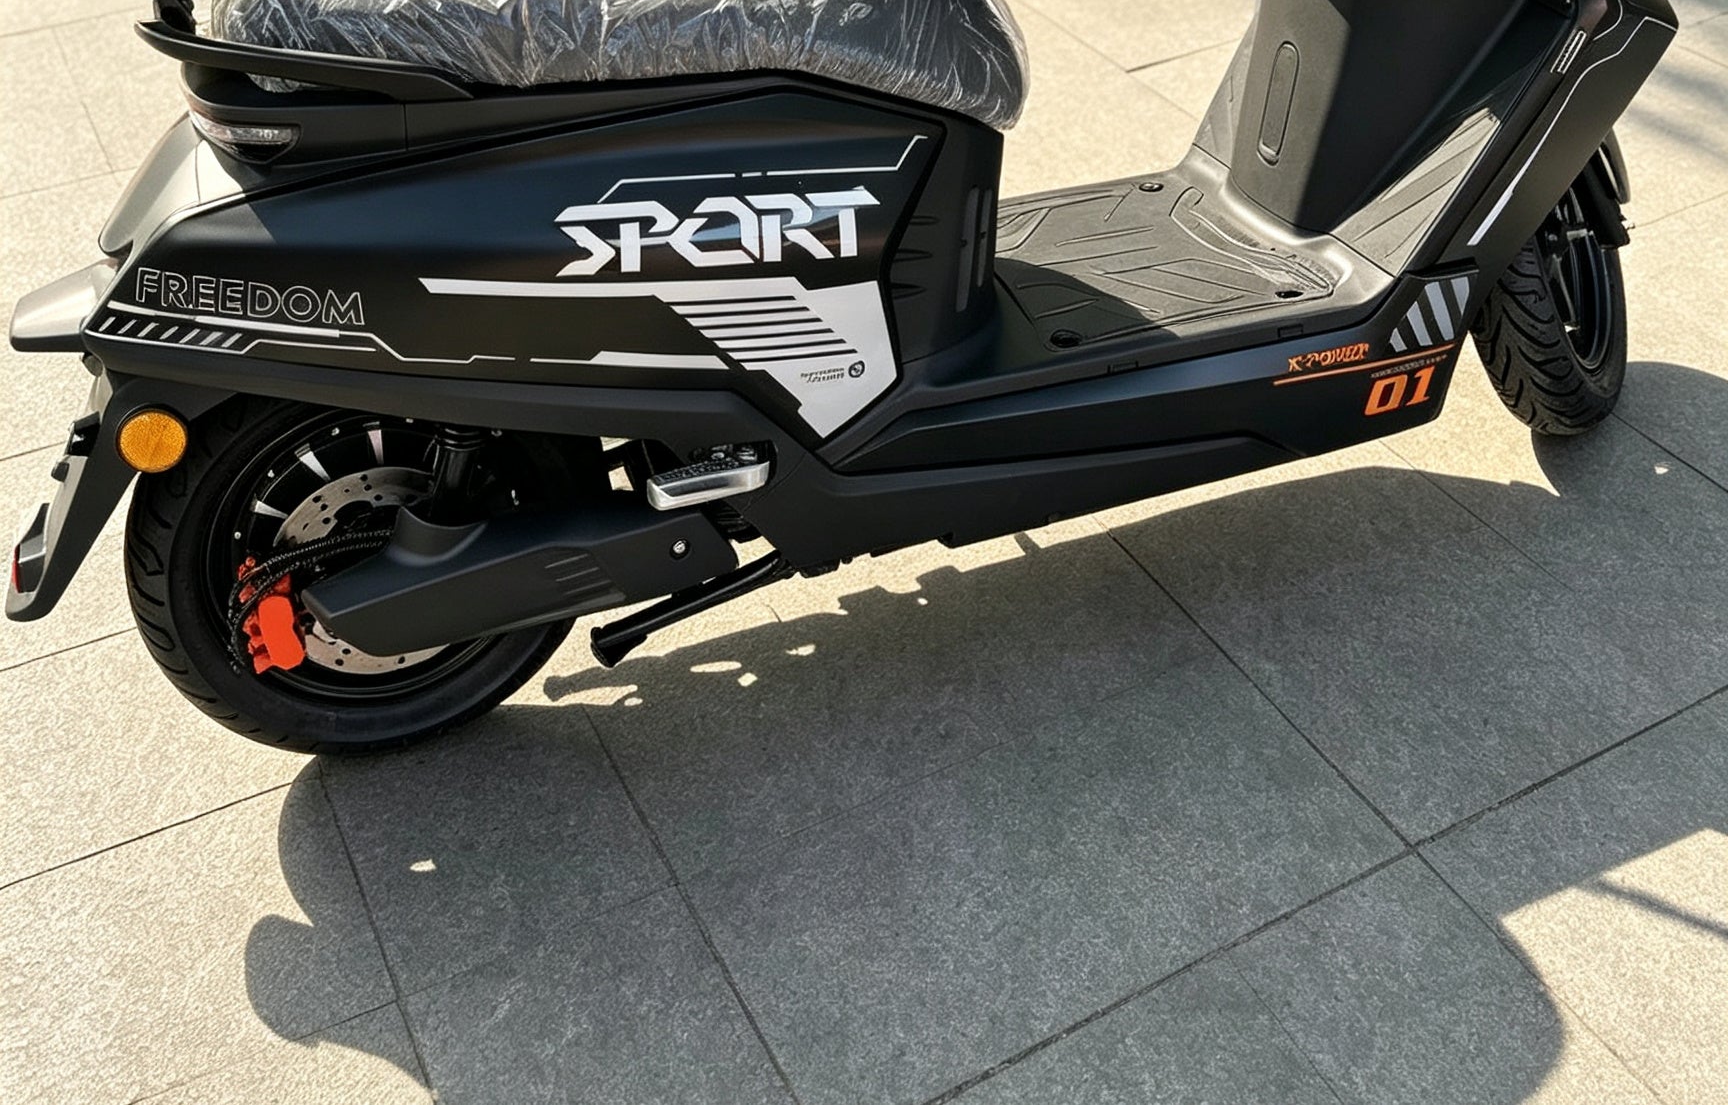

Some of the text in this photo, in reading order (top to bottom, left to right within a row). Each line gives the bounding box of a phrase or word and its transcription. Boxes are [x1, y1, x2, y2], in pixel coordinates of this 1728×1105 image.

[554, 186, 880, 277] SPORT
[136, 267, 365, 325] FREEDOM
[1364, 366, 1435, 416] 01
